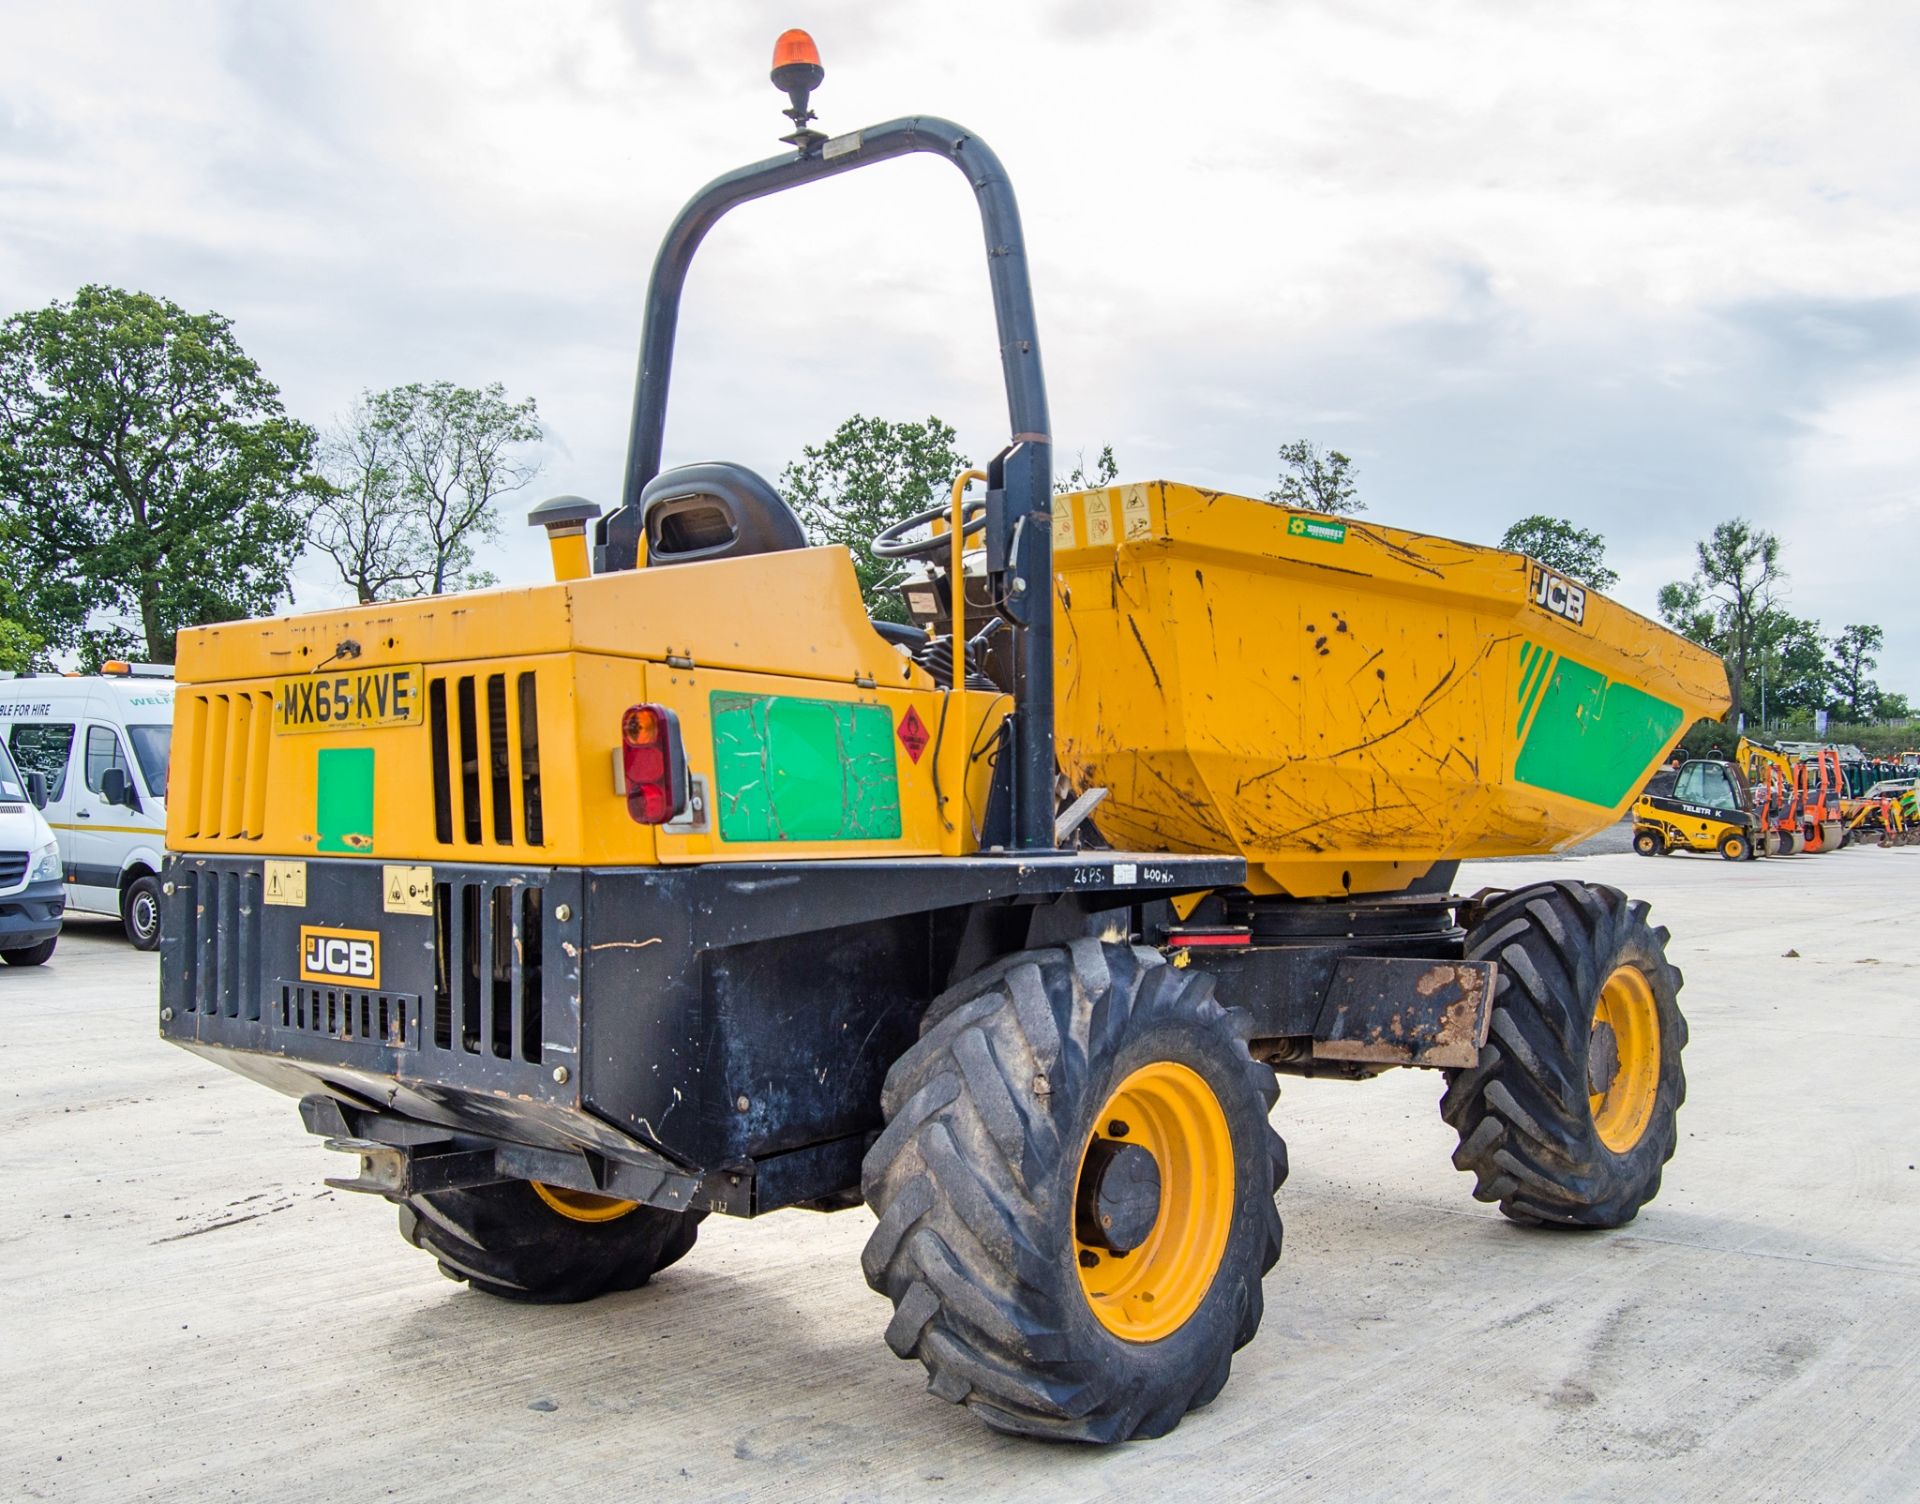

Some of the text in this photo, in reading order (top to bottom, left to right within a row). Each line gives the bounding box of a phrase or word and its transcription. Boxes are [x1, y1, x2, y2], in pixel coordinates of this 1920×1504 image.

[1531, 571, 1585, 624] JCB
[13, 703, 31, 716] FOR
[31, 703, 51, 716] HIRE
[129, 696, 175, 706] WELF
[284, 671, 410, 725] MX65 KVE
[1682, 804, 1722, 817] TELETRK
[306, 938, 374, 976] JCB
